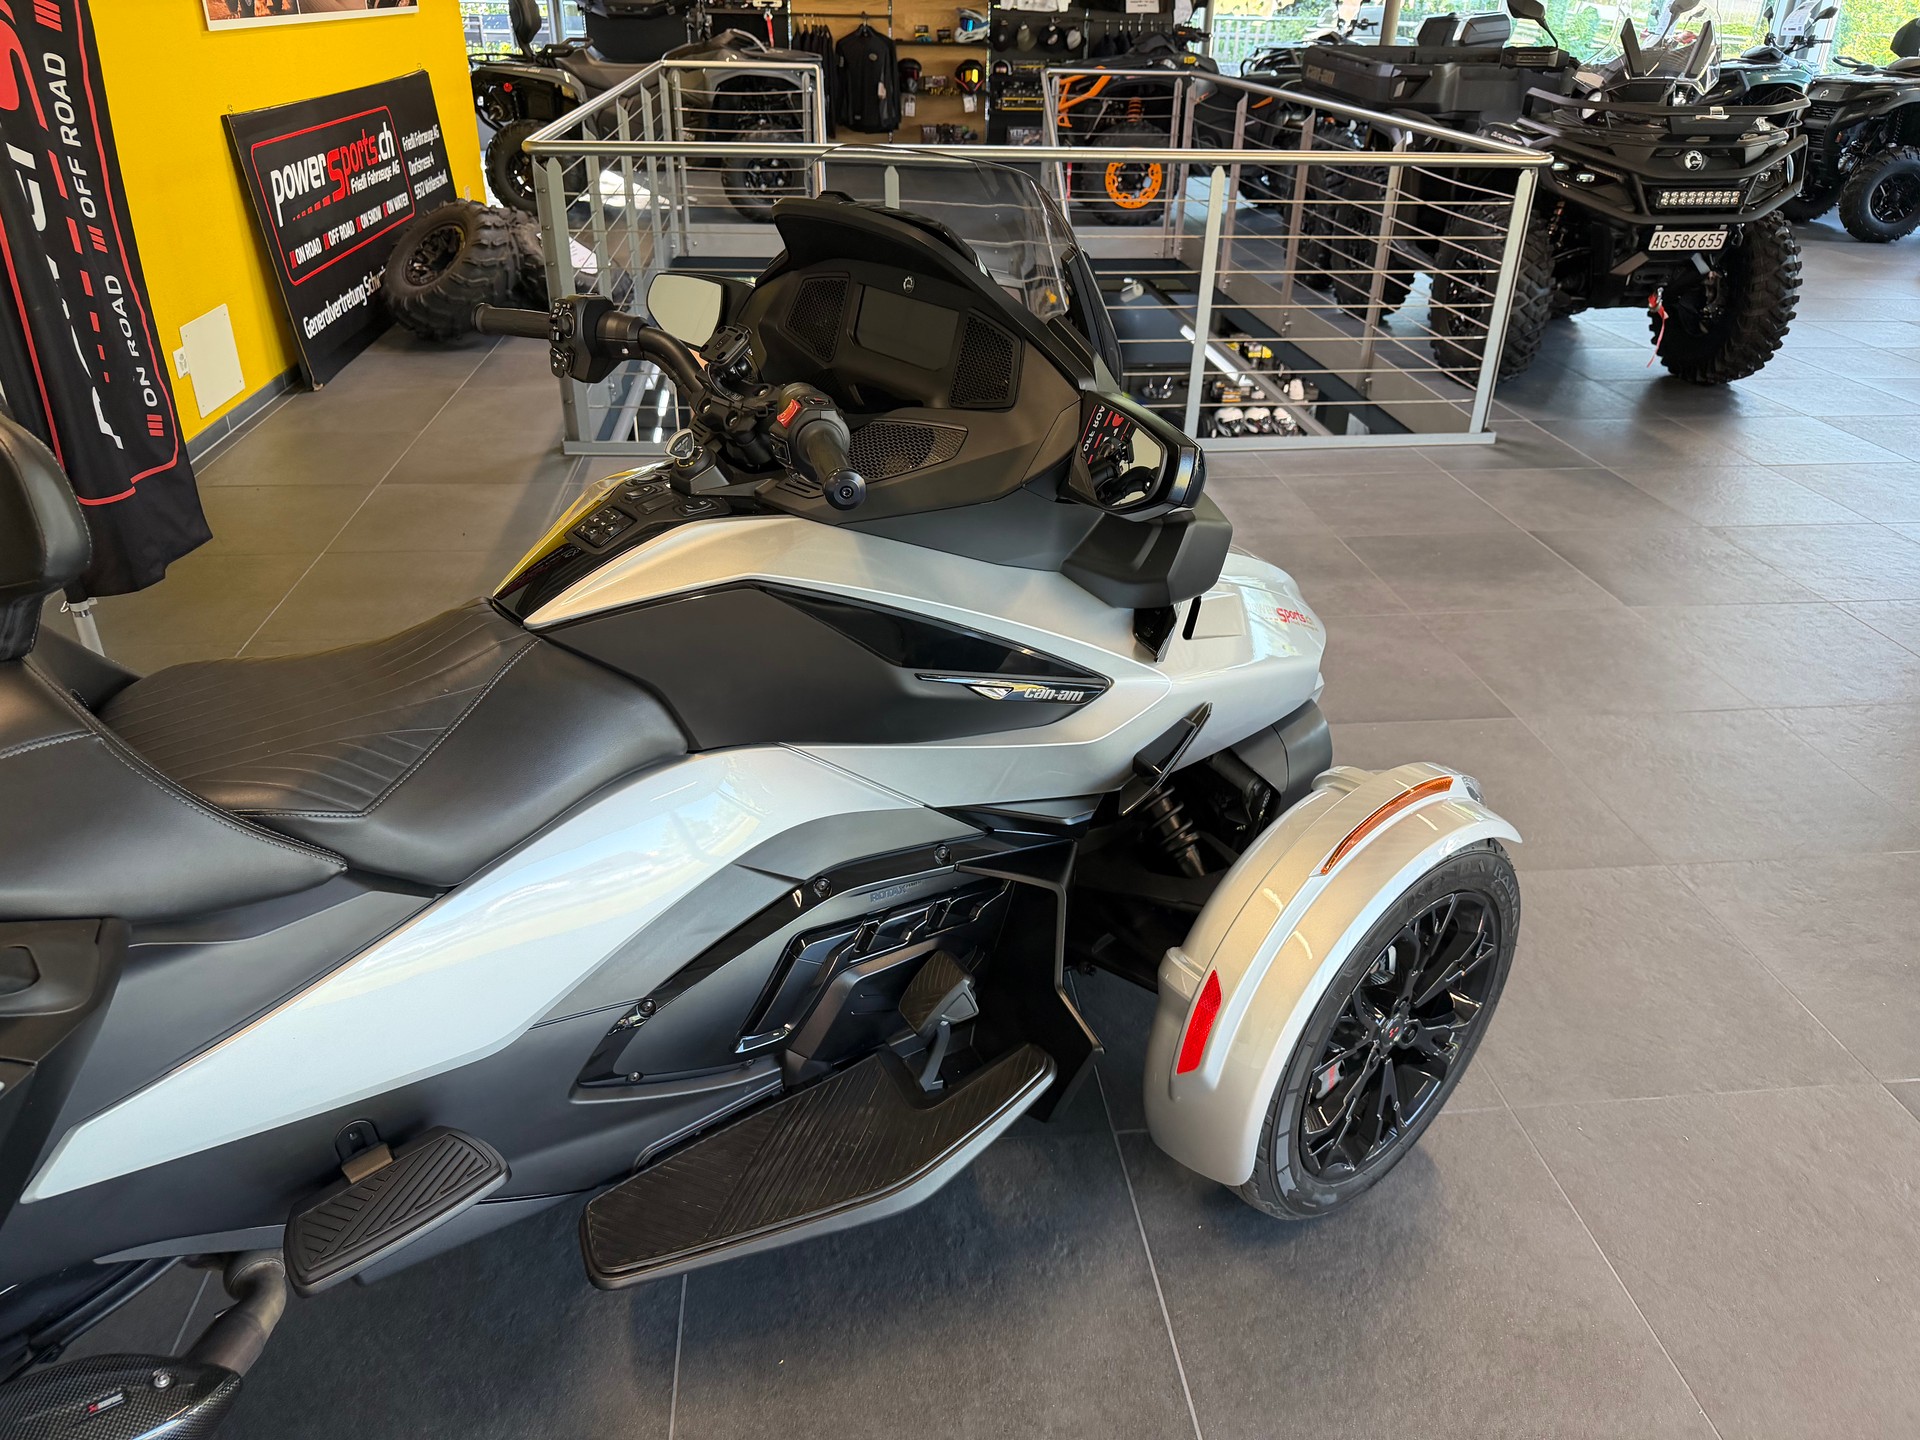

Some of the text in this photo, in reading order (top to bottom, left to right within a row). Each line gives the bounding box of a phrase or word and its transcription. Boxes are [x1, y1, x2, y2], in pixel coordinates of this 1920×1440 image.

[43, 52, 82, 147] ROAD
[67, 155, 97, 219] OFF
[350, 176, 368, 195] Friedli
[391, 160, 401, 176] AG
[360, 205, 383, 229] ON SNOW
[386, 191, 410, 215] ON WATER
[328, 219, 356, 247] OFF ROAD
[295, 237, 322, 265] ON ROAD
[104, 274, 140, 357] ROAD
[303, 265, 387, 340] Generalvertretung Schw
[136, 367, 158, 407] ON
[1023, 687, 1085, 702] can-am
